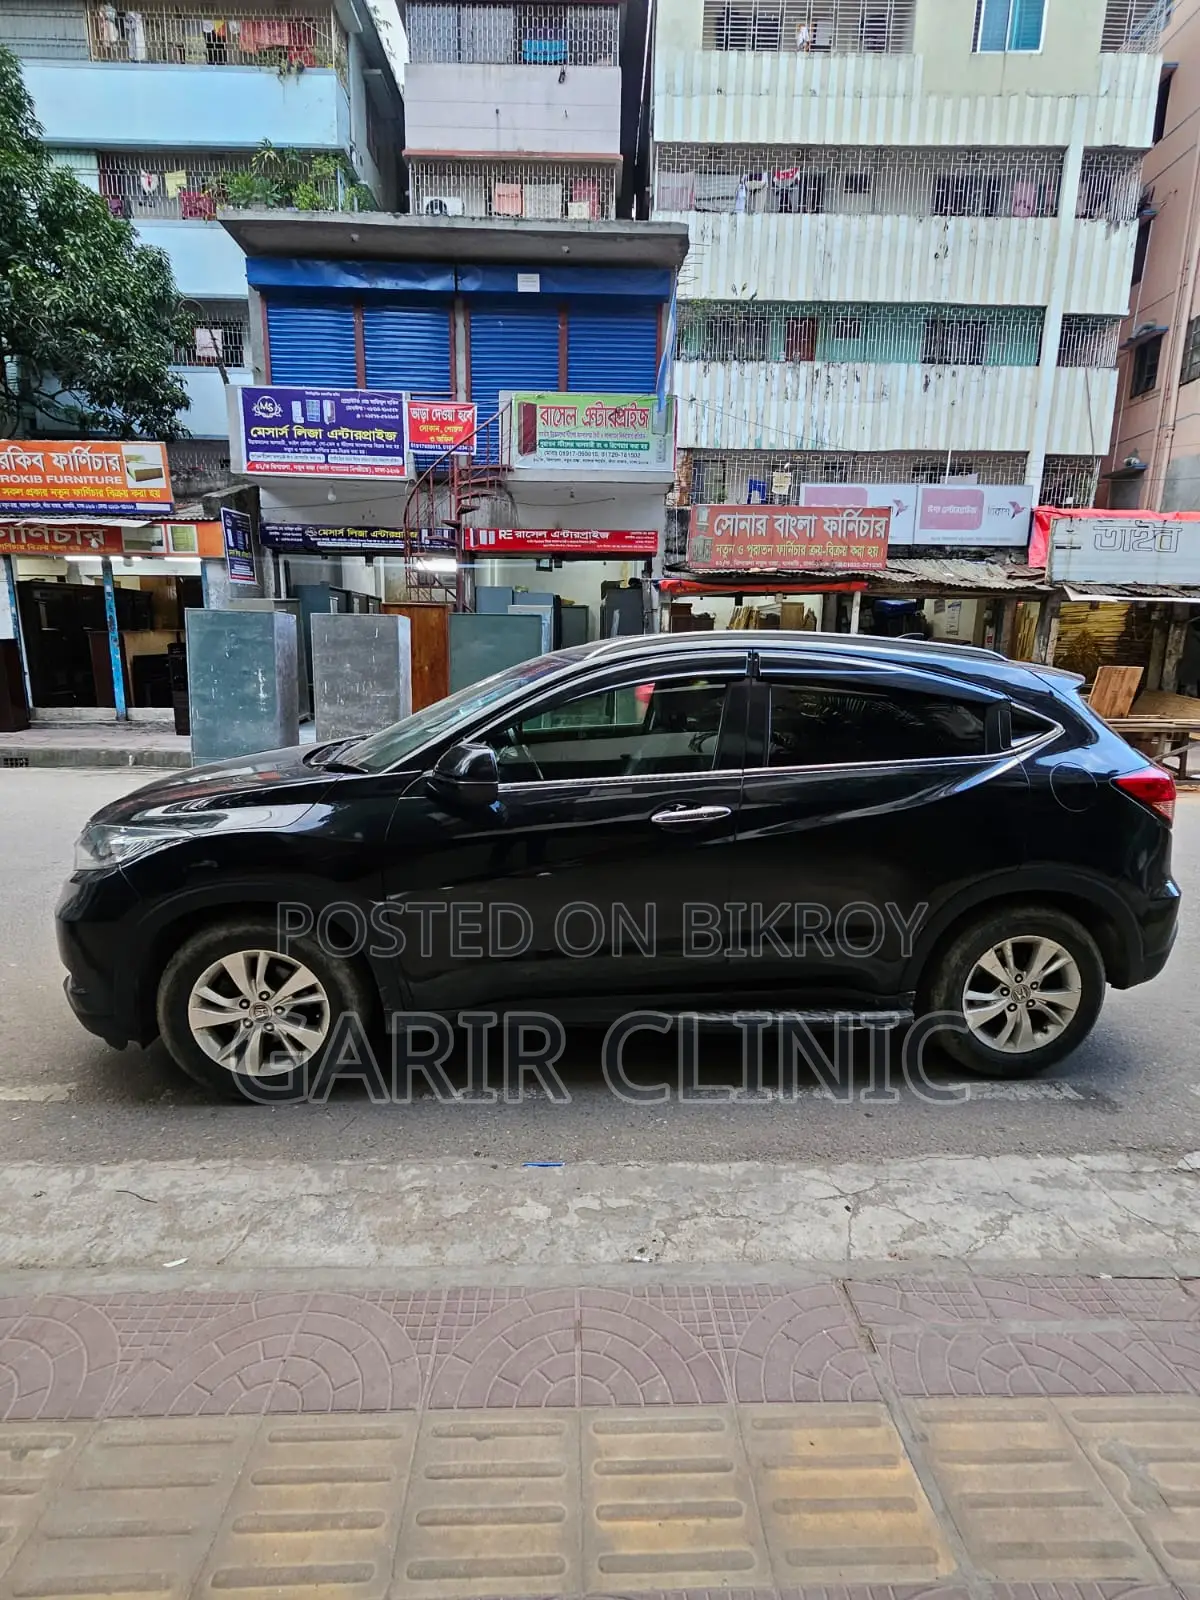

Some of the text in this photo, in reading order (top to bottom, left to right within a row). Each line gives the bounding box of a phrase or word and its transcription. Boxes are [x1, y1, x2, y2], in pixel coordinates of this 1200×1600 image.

[539, 401, 650, 430] রাসেল এন্টারপ্রাইজ
[251, 426, 397, 442] মেসার্স লিজা এন্টারপ্রাইজ
[0, 446, 45, 472] রকিব
[0, 475, 124, 484] ROKIB FURNITURE
[714, 512, 769, 537] সোনার
[774, 513, 818, 539] বাংলা
[514, 529, 546, 539] রাসেল
[550, 528, 610, 540] এন্টারপ্রাইজ
[716, 544, 735, 559] নতুন
[738, 545, 743, 555] ও
[747, 545, 773, 559] পুরাতন
[850, 545, 865, 558] করা
